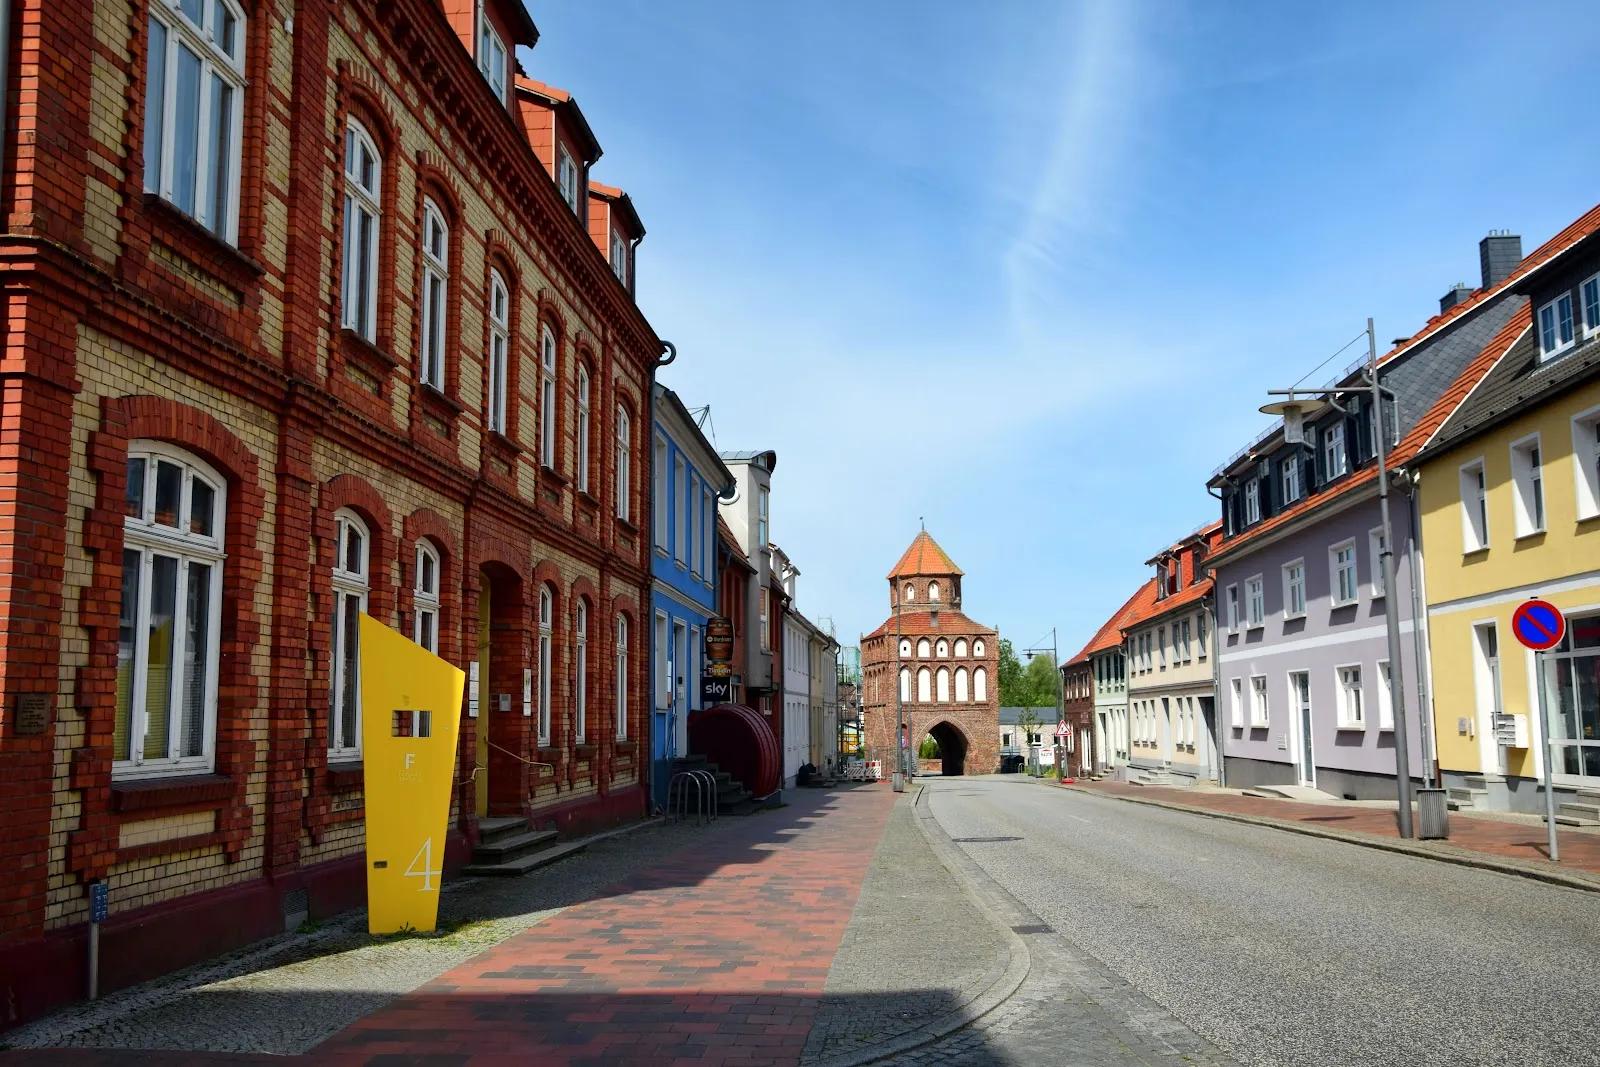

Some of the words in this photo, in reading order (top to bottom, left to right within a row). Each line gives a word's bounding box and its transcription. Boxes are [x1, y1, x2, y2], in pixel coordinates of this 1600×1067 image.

[705, 681, 728, 696] sky
[404, 753, 416, 769] F
[403, 836, 442, 891] 4
